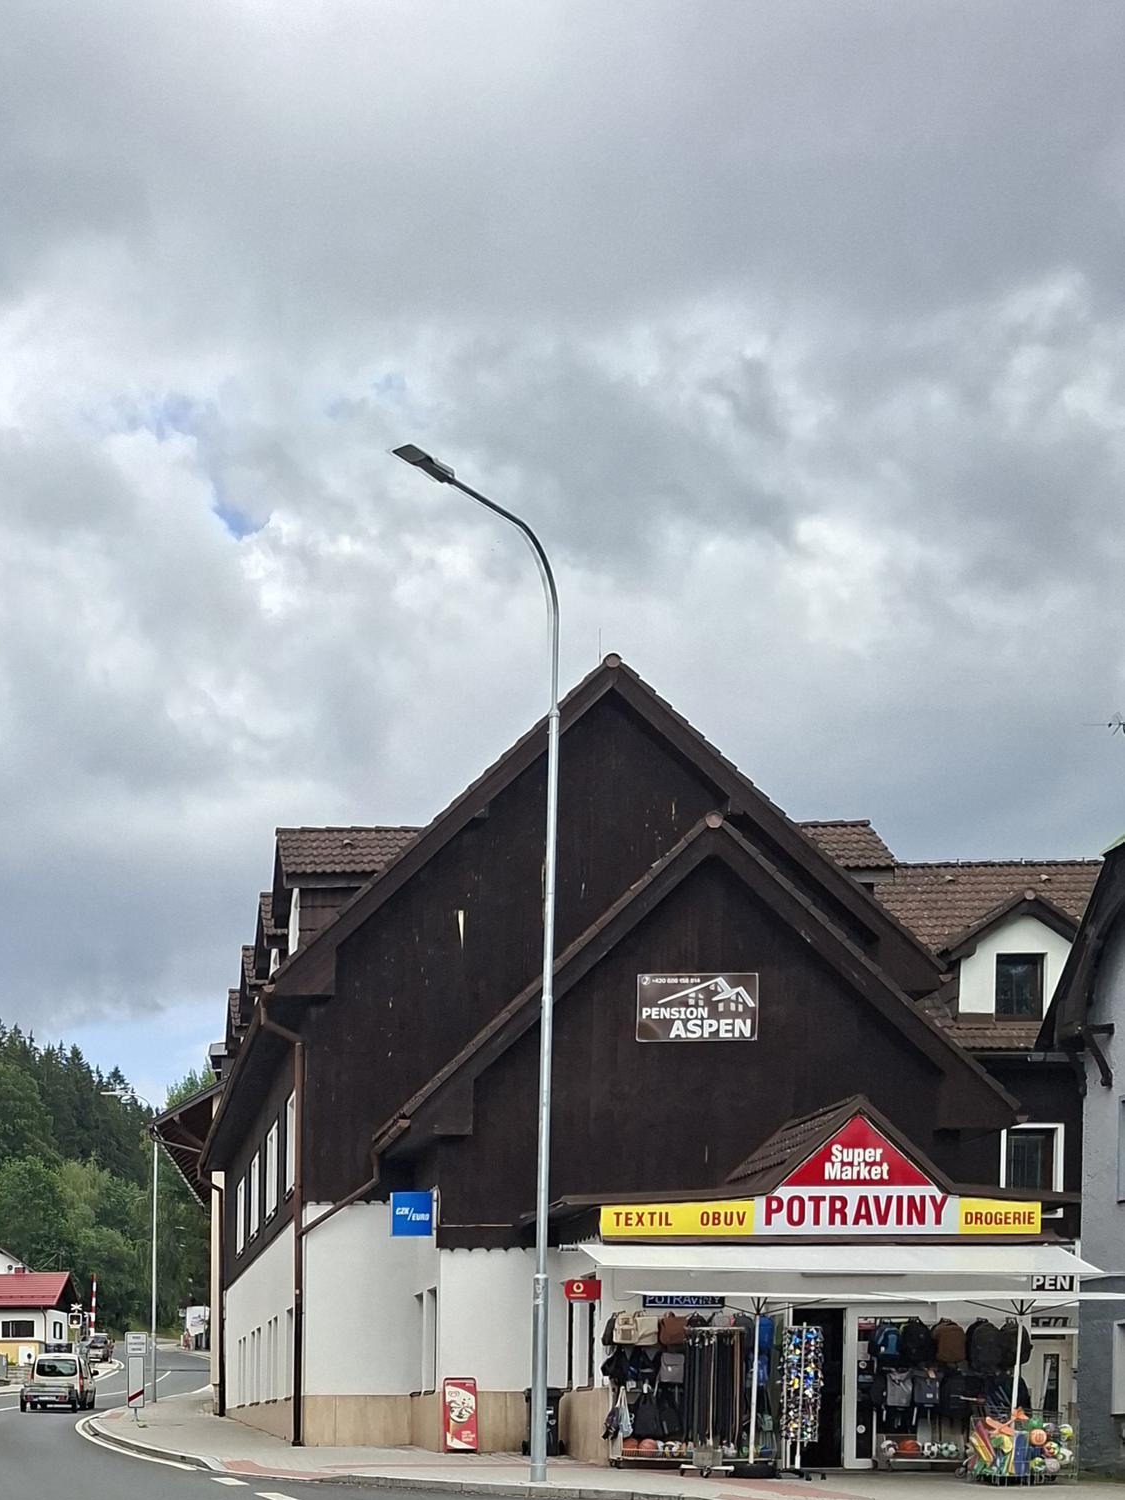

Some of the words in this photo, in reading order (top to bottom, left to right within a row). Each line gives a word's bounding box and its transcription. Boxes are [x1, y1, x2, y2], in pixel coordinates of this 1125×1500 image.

[642, 1007, 708, 1019] PENSION
[669, 1019, 752, 1038] ASPEN
[831, 1144, 883, 1165] Super
[824, 1162, 889, 1181] Market
[613, 1211, 673, 1227] TEXTIL
[700, 1211, 747, 1227] OBUV
[764, 1195, 949, 1227] POTRAVINY
[964, 1211, 1035, 1225] DROGERIE
[1032, 1275, 1070, 1290] PEN
